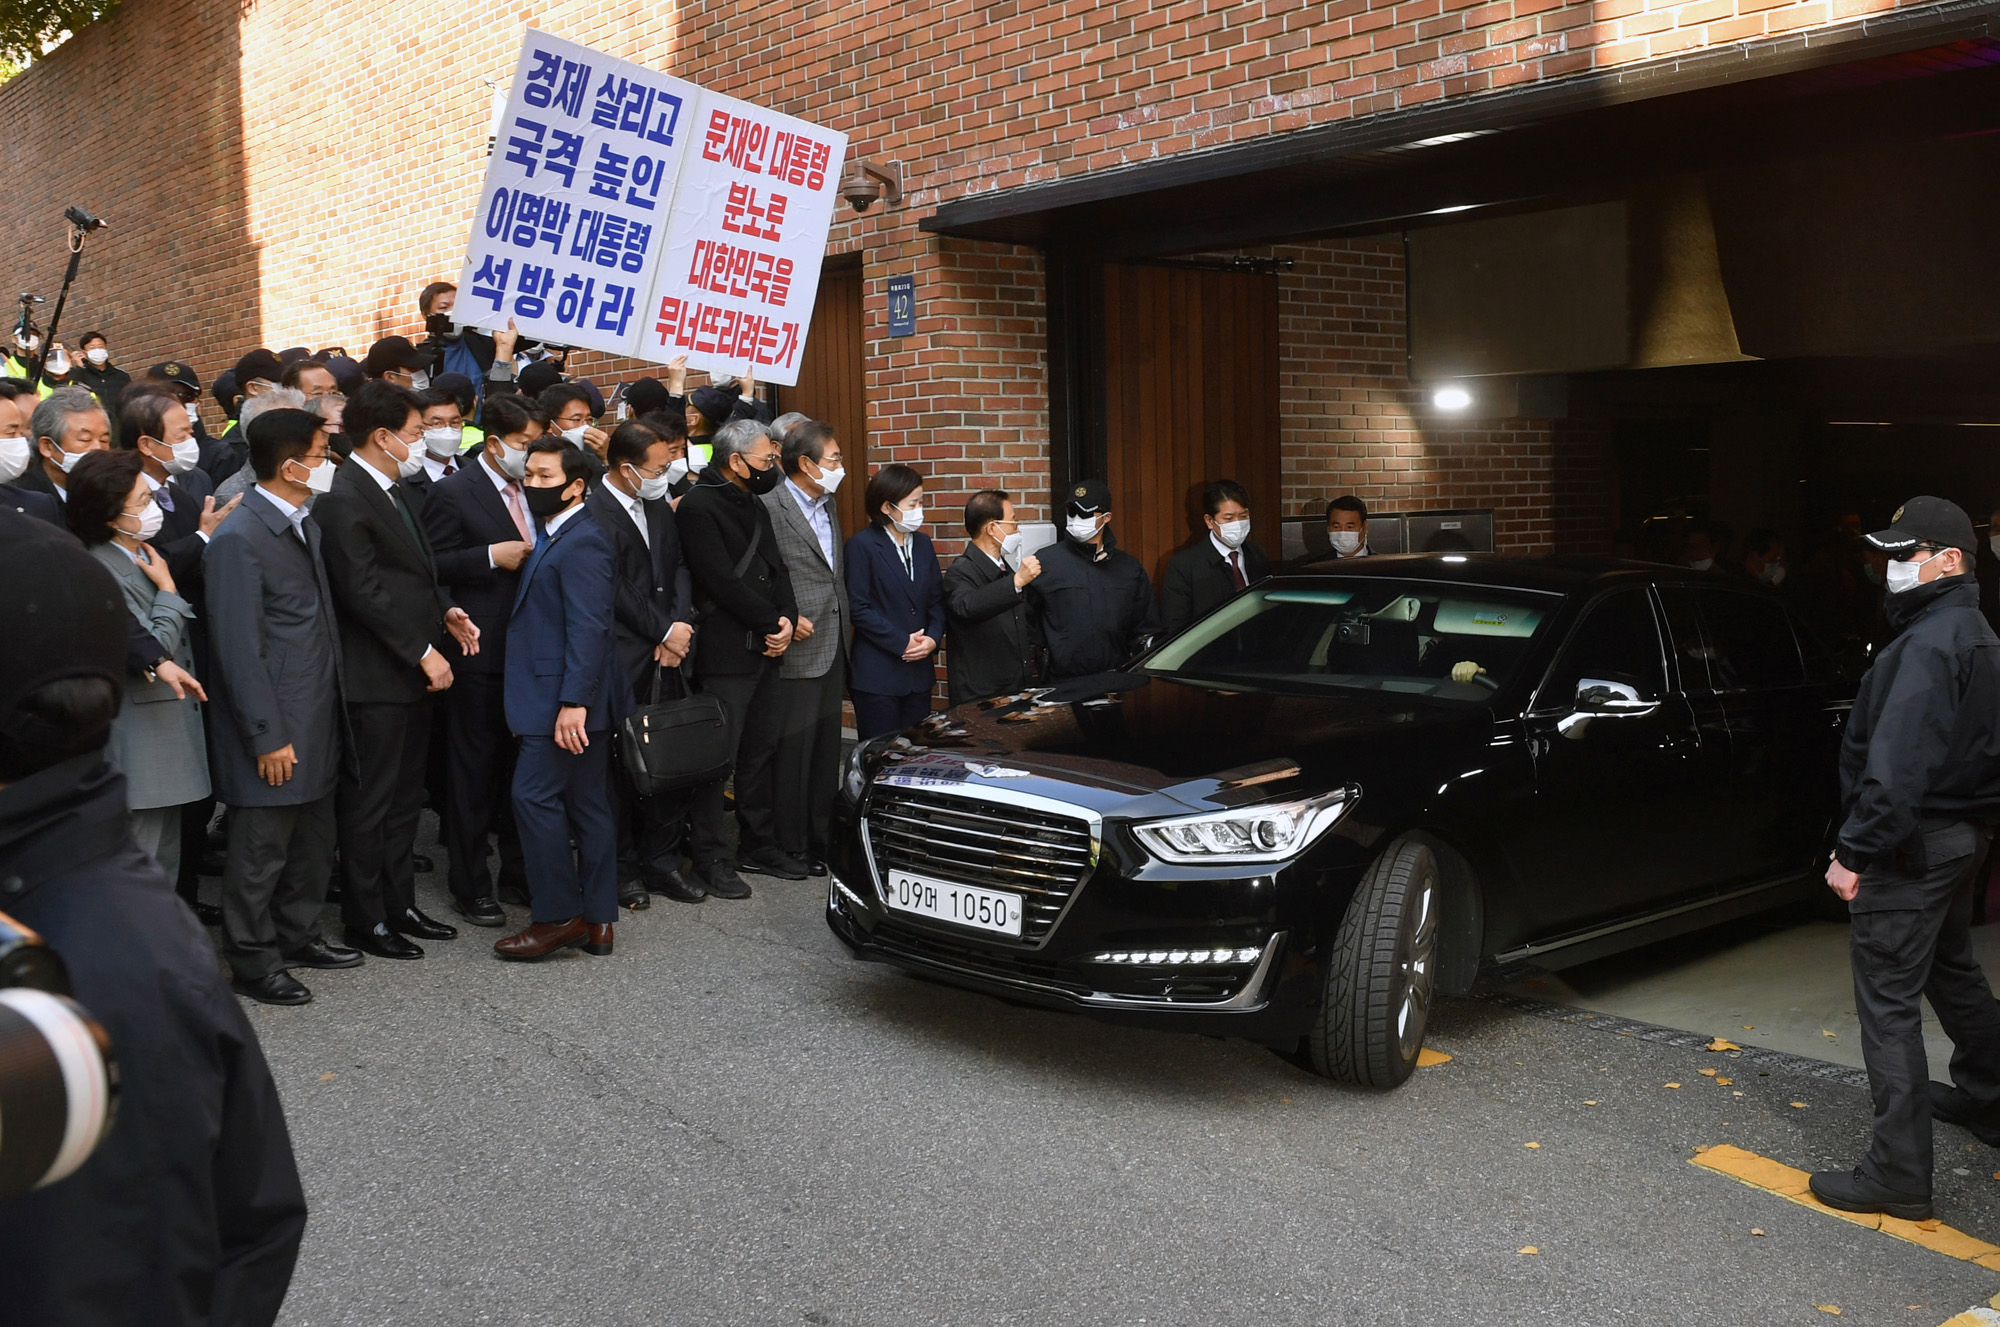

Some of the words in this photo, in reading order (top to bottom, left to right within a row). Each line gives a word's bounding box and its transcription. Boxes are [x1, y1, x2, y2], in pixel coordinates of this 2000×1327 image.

[523, 49, 592, 119] 경제
[591, 73, 683, 147] 살리고
[505, 117, 584, 189] 국격
[588, 142, 666, 211] 높인
[702, 109, 770, 174] 문재인
[768, 131, 832, 192] 대통령
[485, 186, 571, 256] 이명박
[569, 208, 652, 274] 대통령
[722, 181, 788, 243] 분노로
[471, 254, 635, 337] 석방하라
[688, 239, 795, 307] 대한민국을
[894, 294, 909, 320] 42
[655, 296, 800, 369] 무너뜨리려는가
[899, 878, 938, 913] 09머
[949, 889, 1007, 927] 1050
